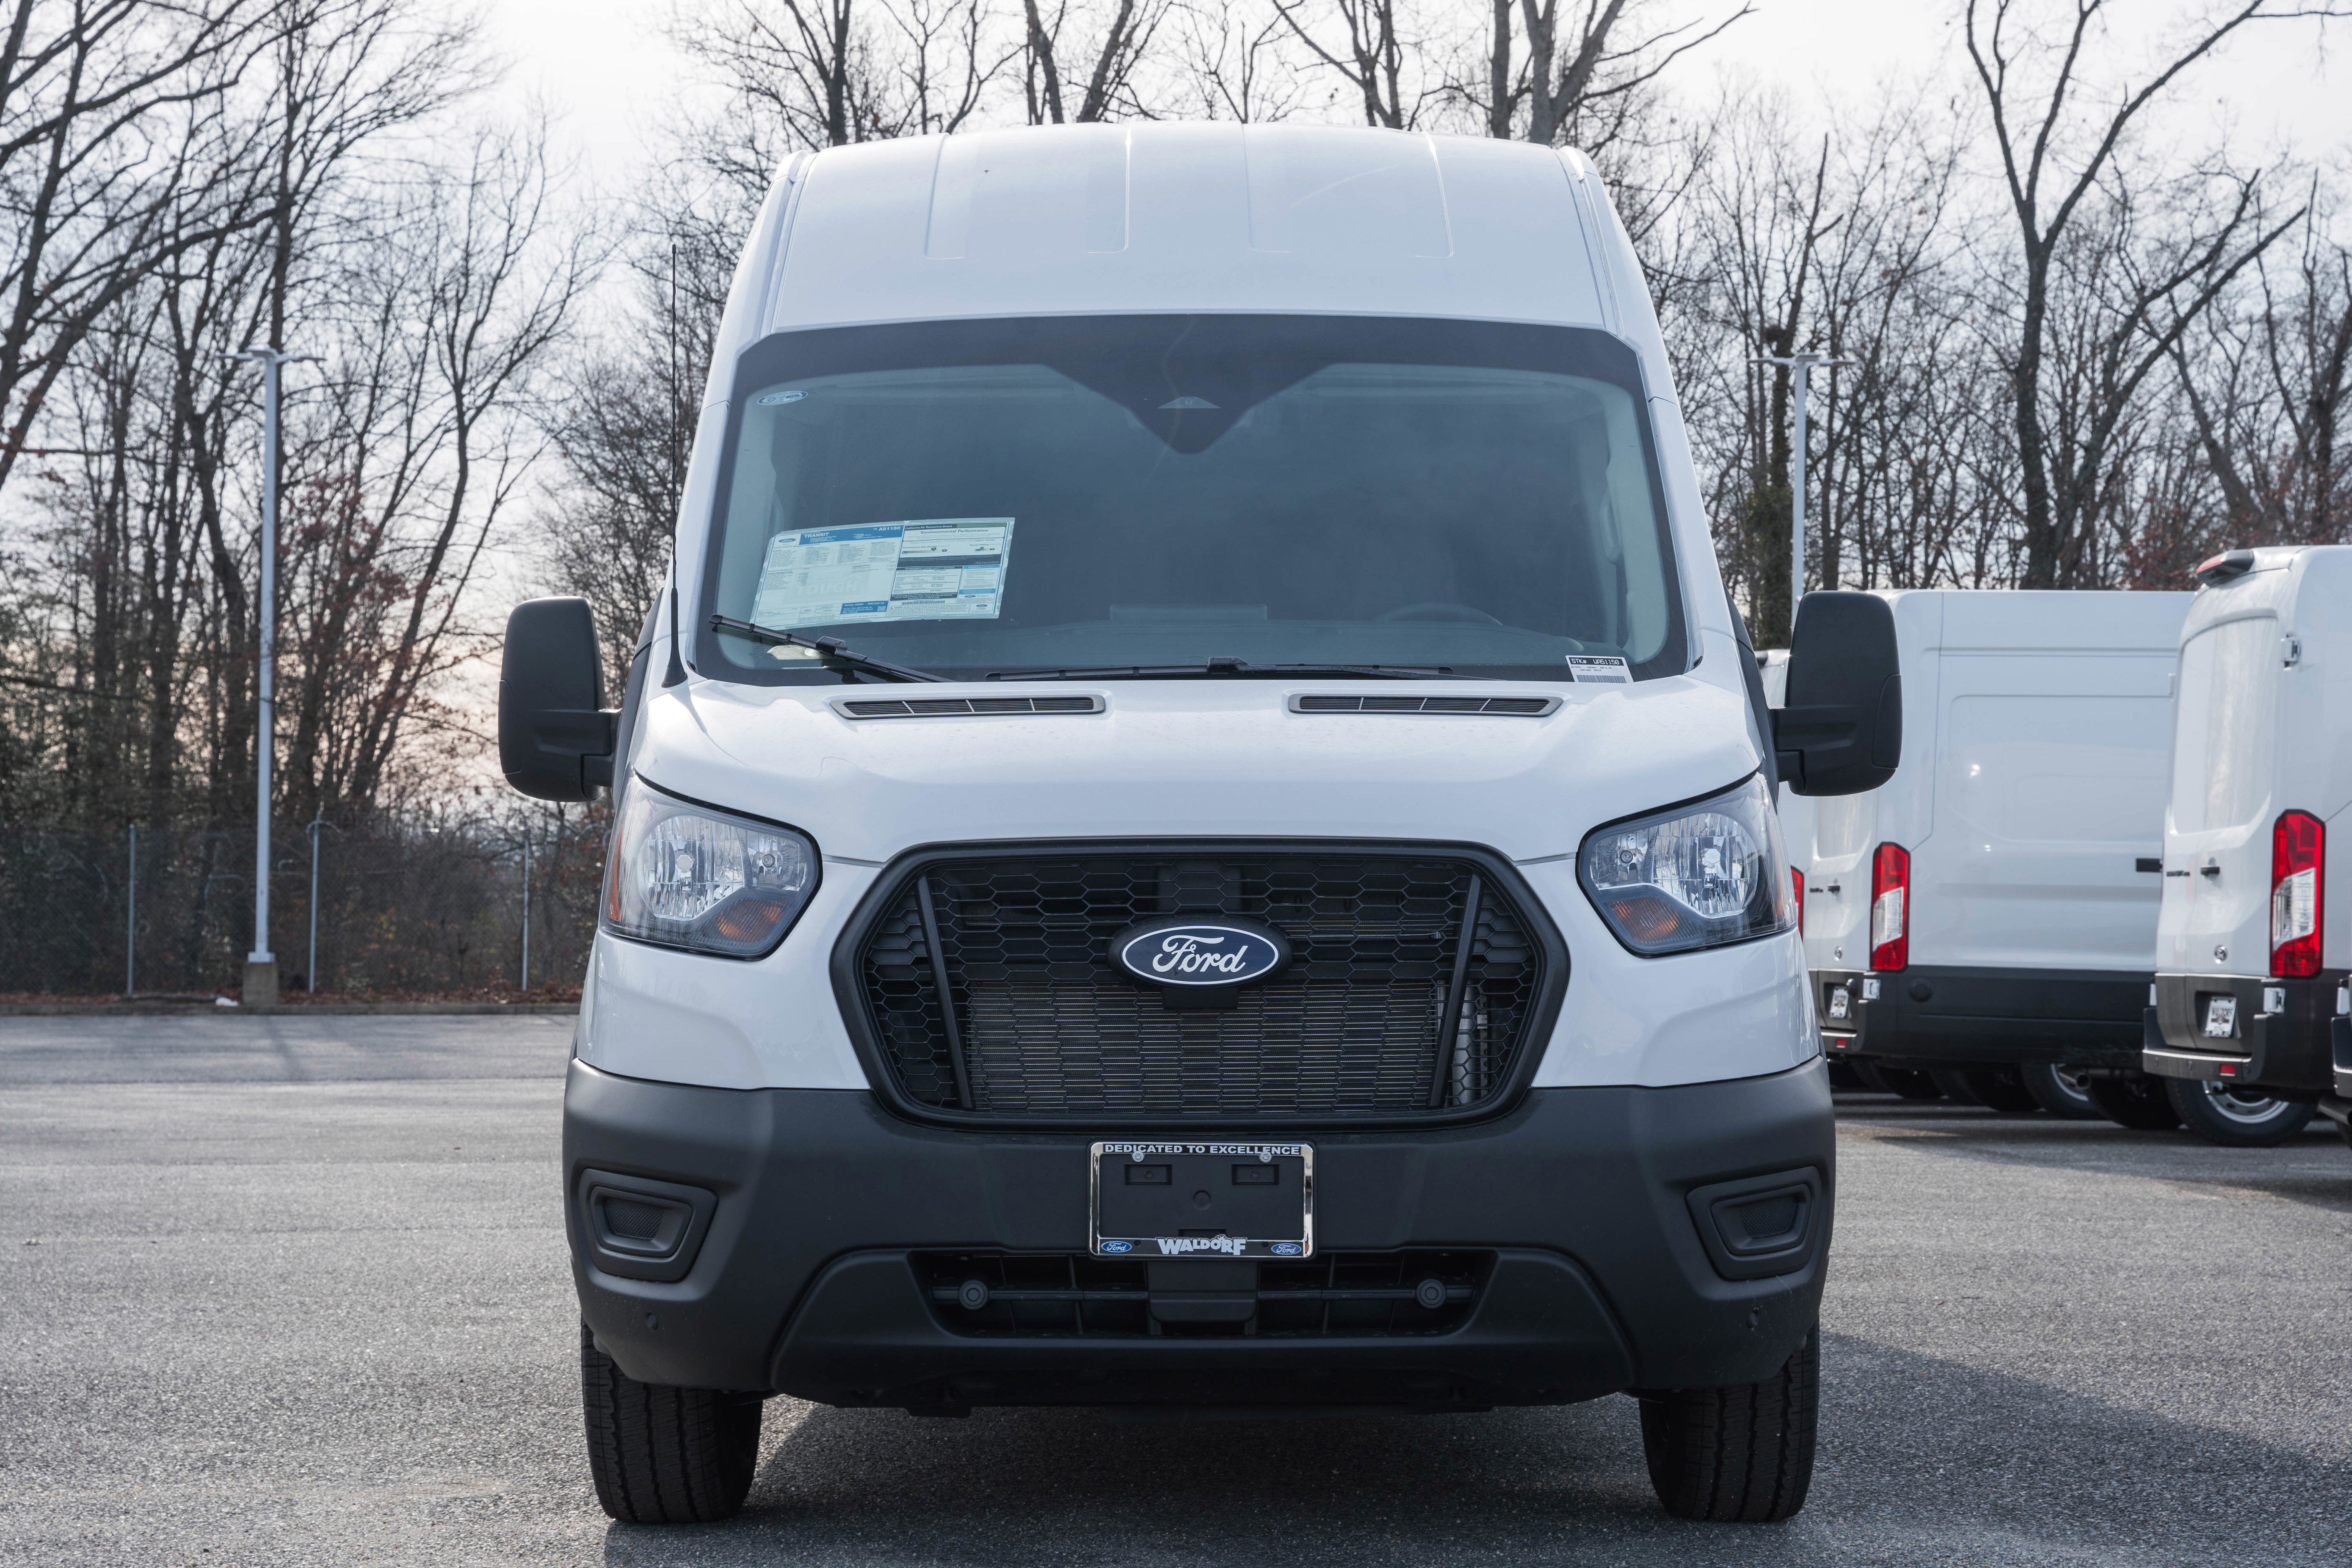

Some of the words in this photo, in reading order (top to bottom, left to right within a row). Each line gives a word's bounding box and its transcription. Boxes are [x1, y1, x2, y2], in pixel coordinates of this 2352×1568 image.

[1152, 935, 1248, 972] Ford
[1105, 1145, 1183, 1153] DEDICATED
[1187, 1145, 1205, 1154] TO
[1210, 1146, 1299, 1155] EXCELLENCE
[1106, 1242, 1126, 1251] Ford
[1157, 1236, 1246, 1255] WALDORF
[1276, 1245, 1296, 1254] Ford
